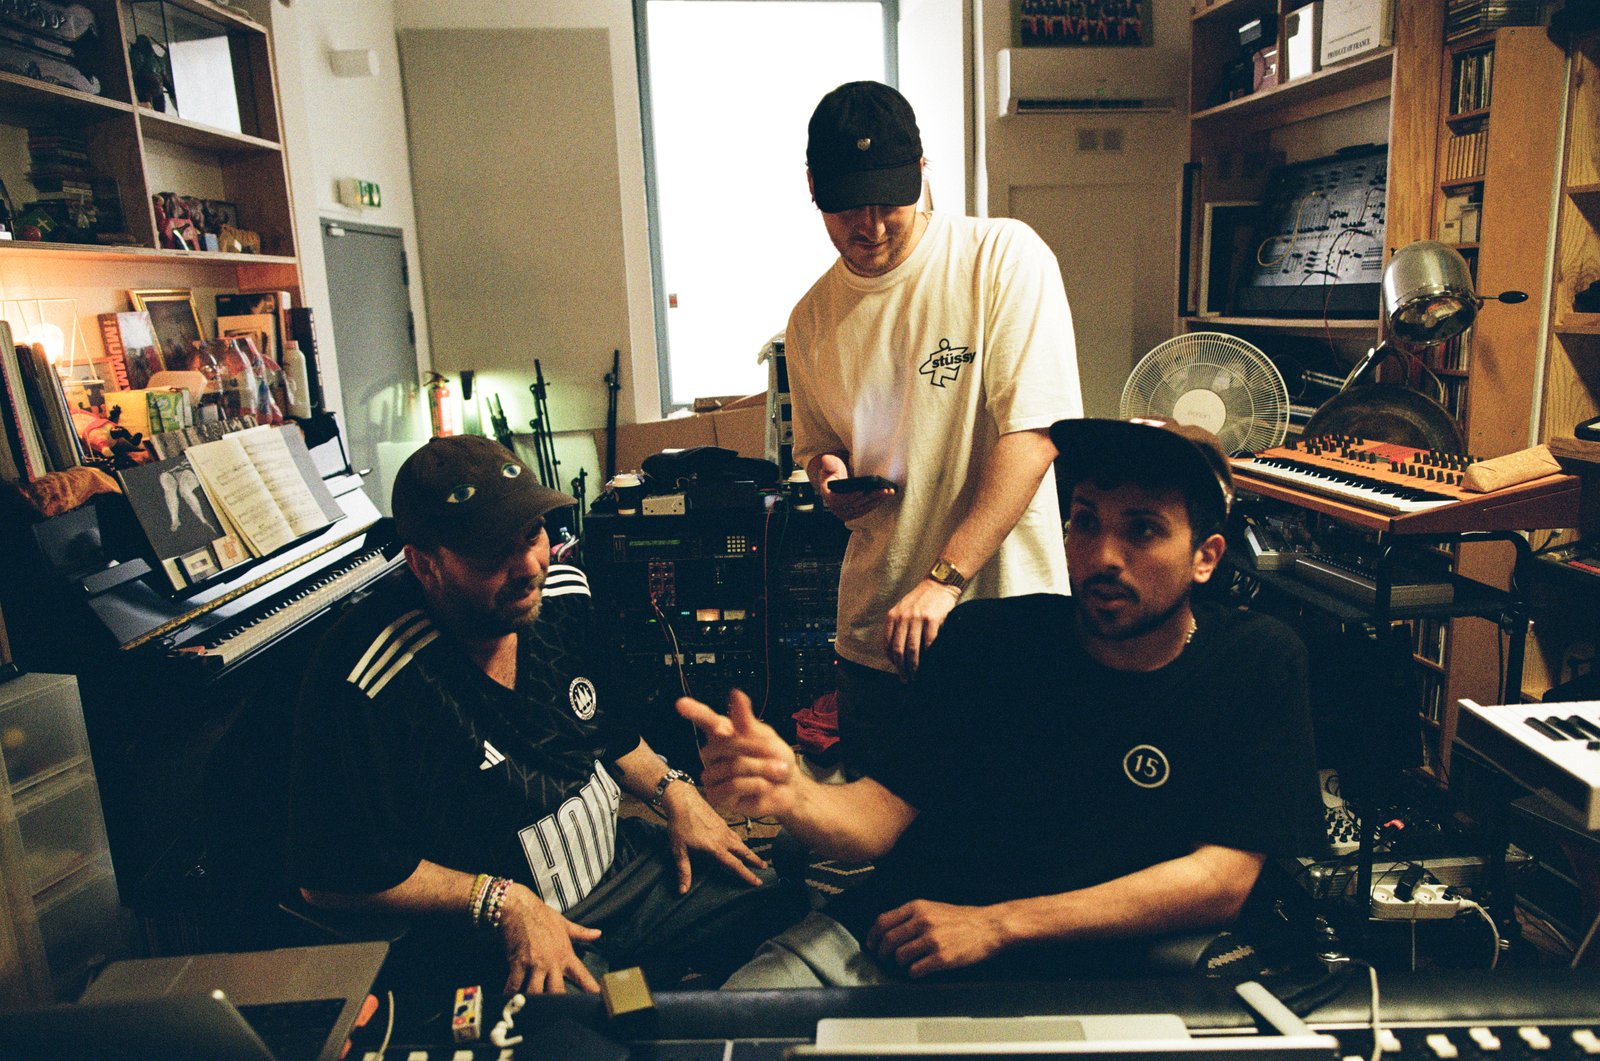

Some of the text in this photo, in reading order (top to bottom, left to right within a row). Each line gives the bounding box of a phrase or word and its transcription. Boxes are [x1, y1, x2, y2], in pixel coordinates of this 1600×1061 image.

[1327, 46, 1347, 59] PRODUCT
[1353, 38, 1370, 51] FRANCE
[932, 351, 976, 368] stüssy
[1134, 754, 1159, 778] 15
